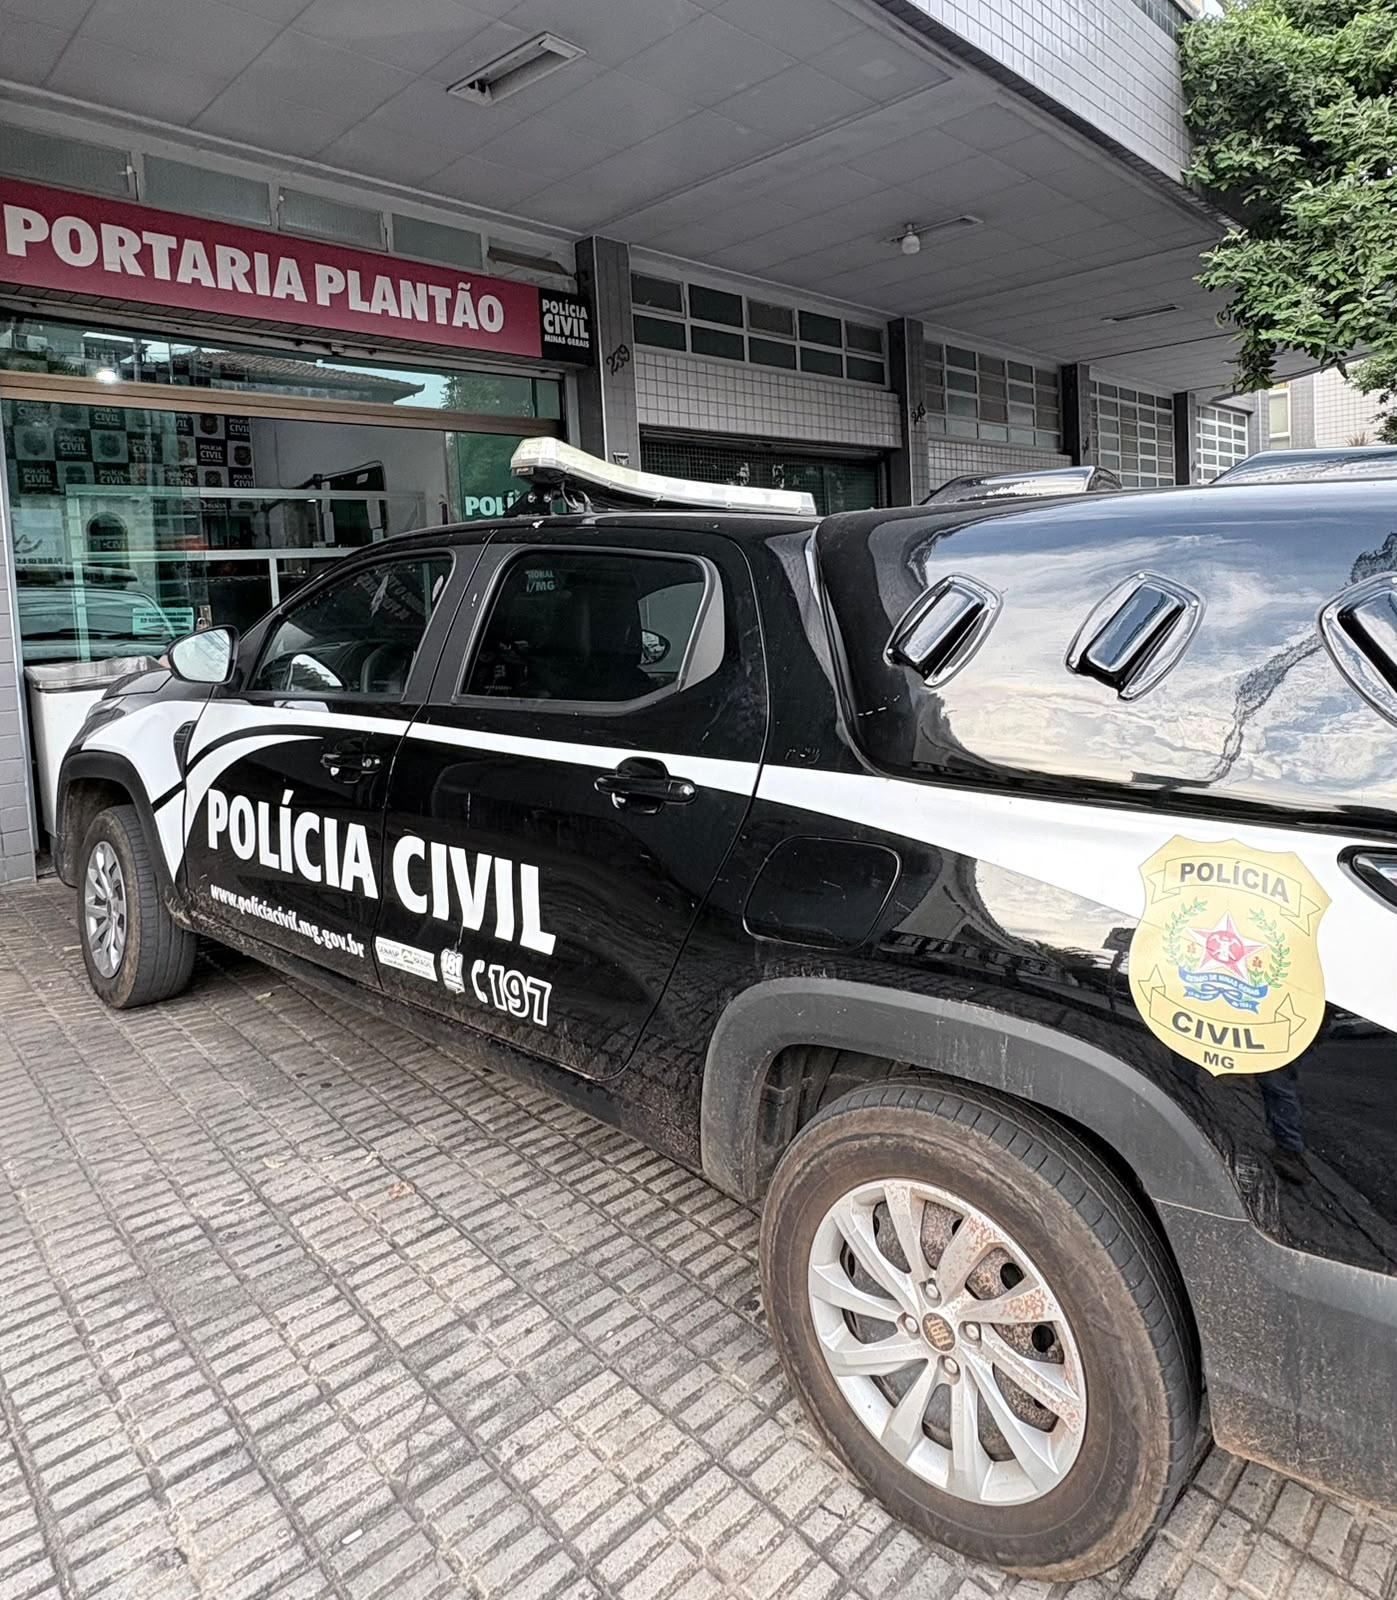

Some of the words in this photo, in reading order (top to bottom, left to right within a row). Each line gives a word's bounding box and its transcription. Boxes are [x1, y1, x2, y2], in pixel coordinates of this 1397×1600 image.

[3, 204, 308, 303] PORTARIA
[314, 262, 505, 333] PLANTÃO
[542, 298, 588, 320] POLÍCIA
[543, 313, 589, 339] CIVIL
[544, 334, 566, 344] MINAS
[567, 338, 589, 348] GERAIS
[60, 442, 87, 452] CIVIL
[200, 450, 223, 459] CIVIL
[24, 474, 53, 484] CIVIL
[465, 489, 520, 516] POLÍ
[208, 788, 379, 899] POLÍCIA
[392, 835, 556, 955] CIVIL
[1180, 861, 1290, 904] POLÍCIA
[210, 884, 365, 958] www.policiacivil.mg.gov.br
[488, 964, 552, 1026] 197
[1171, 1011, 1265, 1050] CIVIL
[1203, 1051, 1235, 1069] MG
